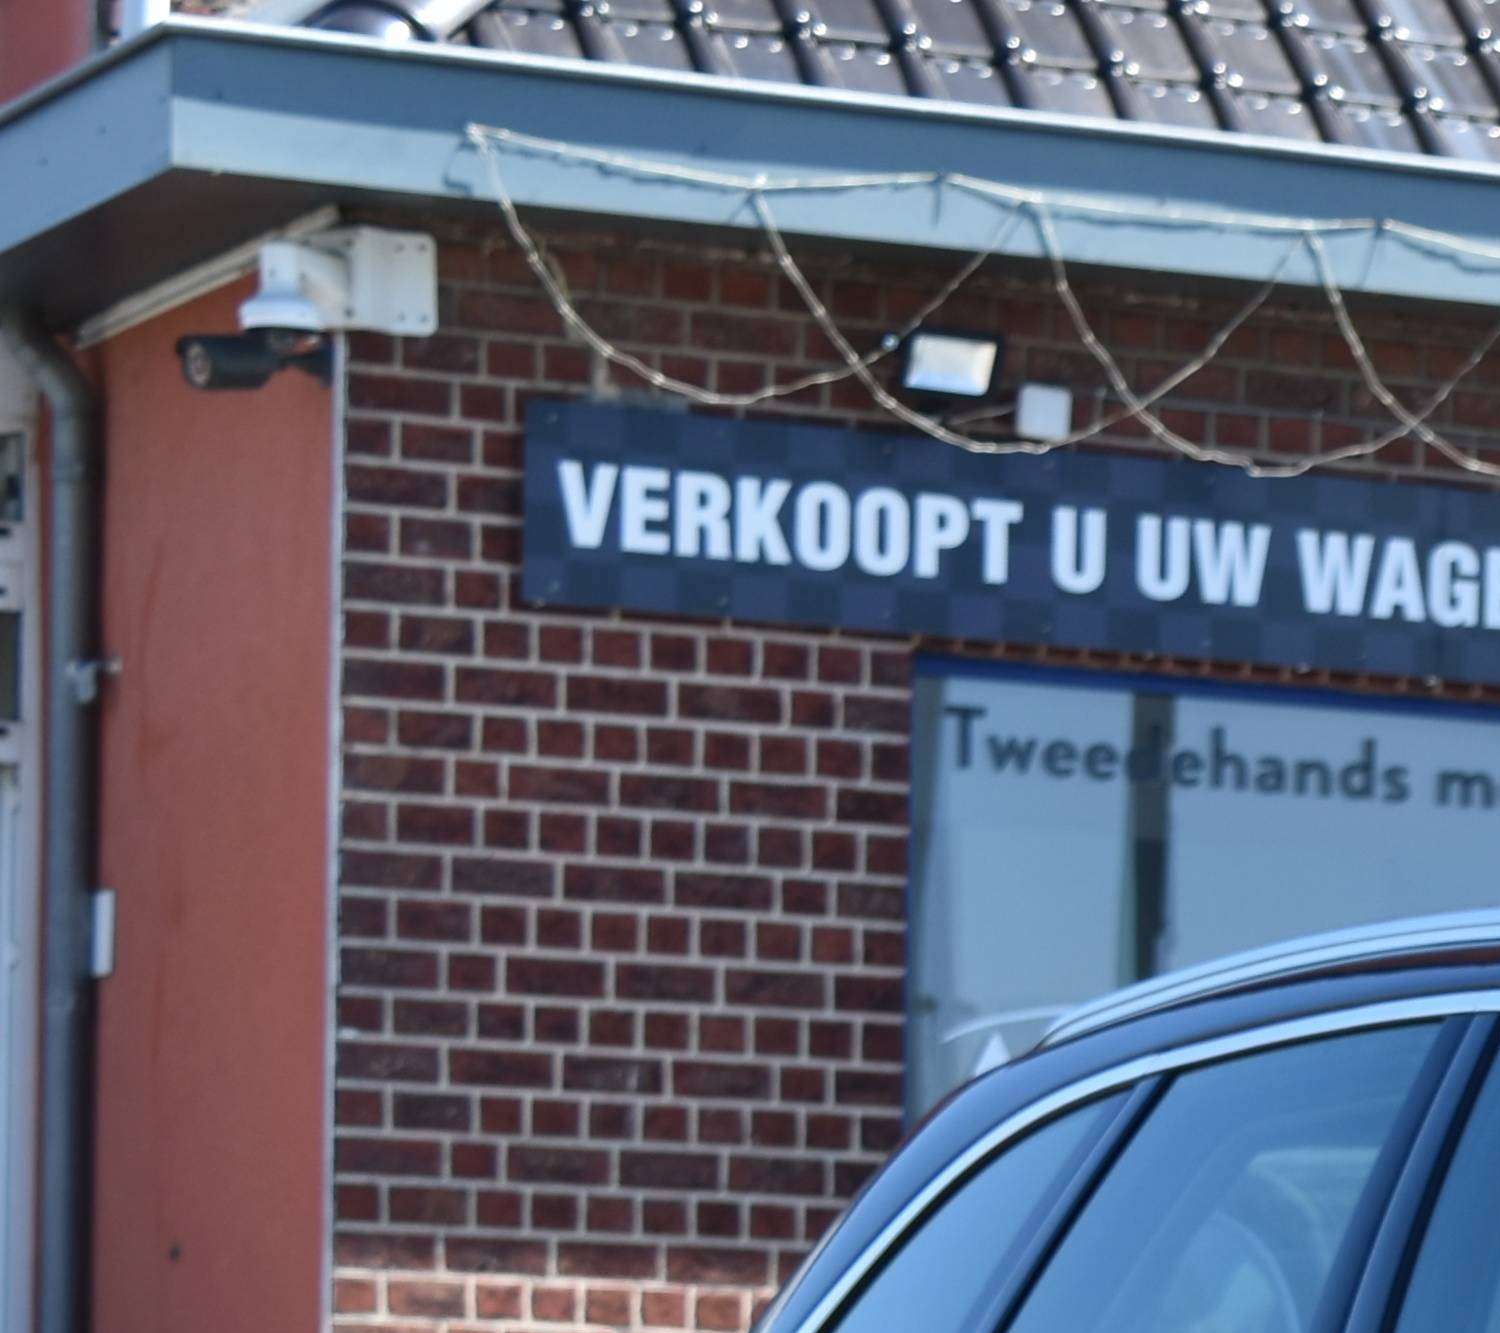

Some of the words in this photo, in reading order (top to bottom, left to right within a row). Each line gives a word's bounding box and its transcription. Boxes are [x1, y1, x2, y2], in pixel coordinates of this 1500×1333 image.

[557, 459, 1024, 585] VERKOOPT
[1051, 507, 1107, 595] U
[1134, 512, 1272, 608] UW
[945, 704, 1410, 803] Tweedehands
